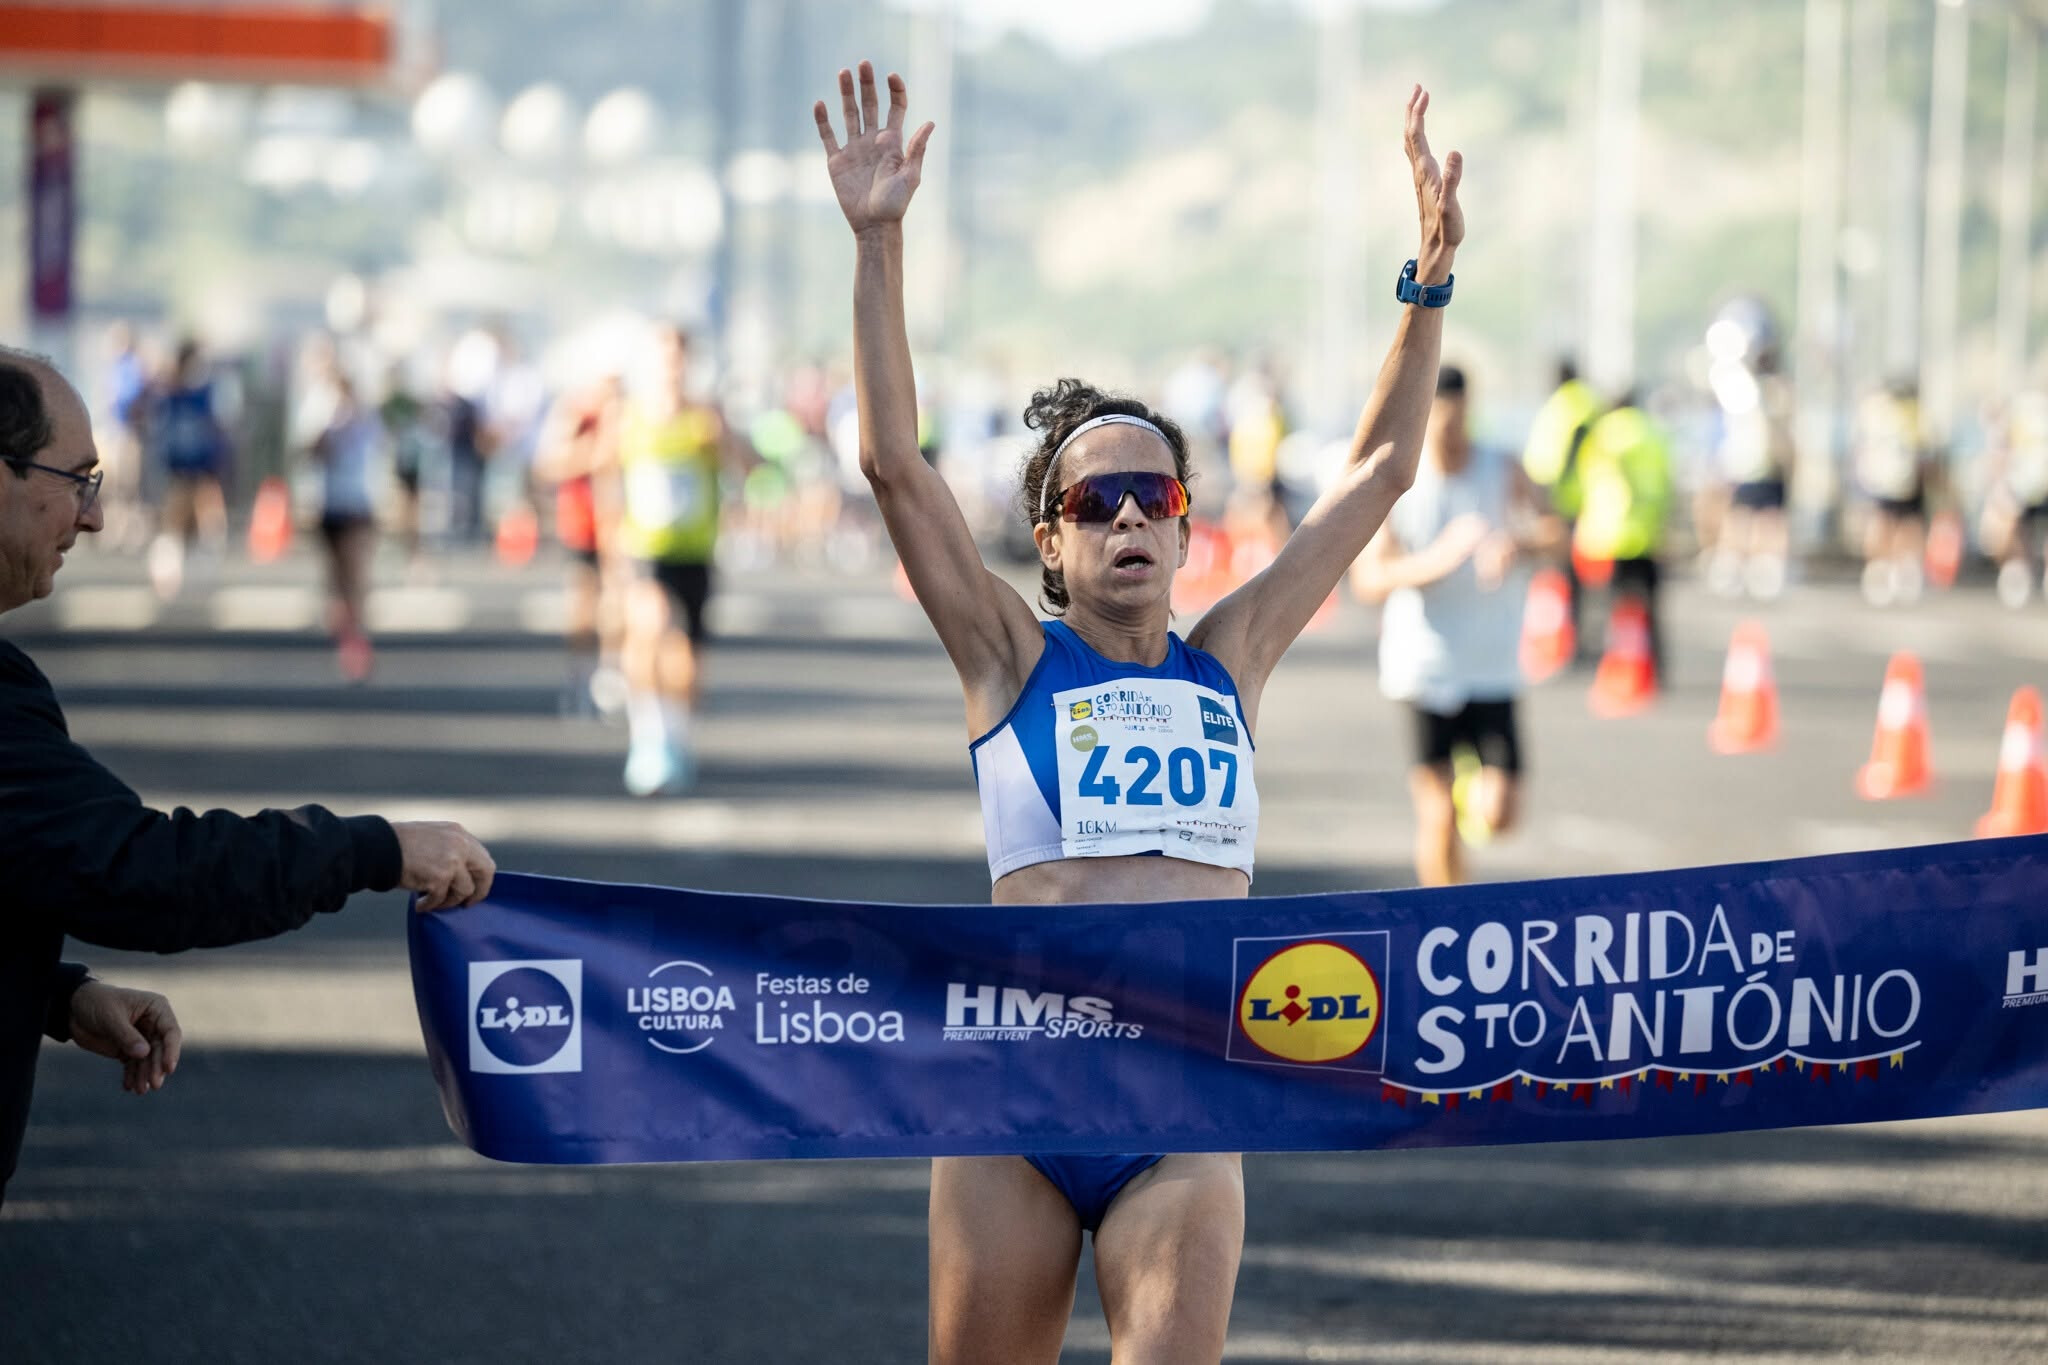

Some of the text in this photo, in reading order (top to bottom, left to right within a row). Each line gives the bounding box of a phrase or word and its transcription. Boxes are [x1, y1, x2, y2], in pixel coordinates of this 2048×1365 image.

[1096, 690, 1145, 705] CORRIDA
[1119, 702, 1172, 717] ANTÓNIO
[1204, 711, 1234, 728] ELITE
[1078, 745, 1238, 808] 4207
[1077, 820, 1117, 834] 10KM
[1416, 904, 1795, 996] CORRIDA DE
[756, 973, 869, 995] Festas de
[627, 986, 736, 1013] LISBOA
[946, 982, 1113, 1027] HMS
[639, 1014, 724, 1031] CULTURA
[756, 1000, 905, 1044] Lisboa
[1557, 969, 1921, 1064] ANTÓNIO
[943, 1030, 1032, 1041] PREMIUM EVENT
[1045, 1018, 1144, 1040] SPORTS
